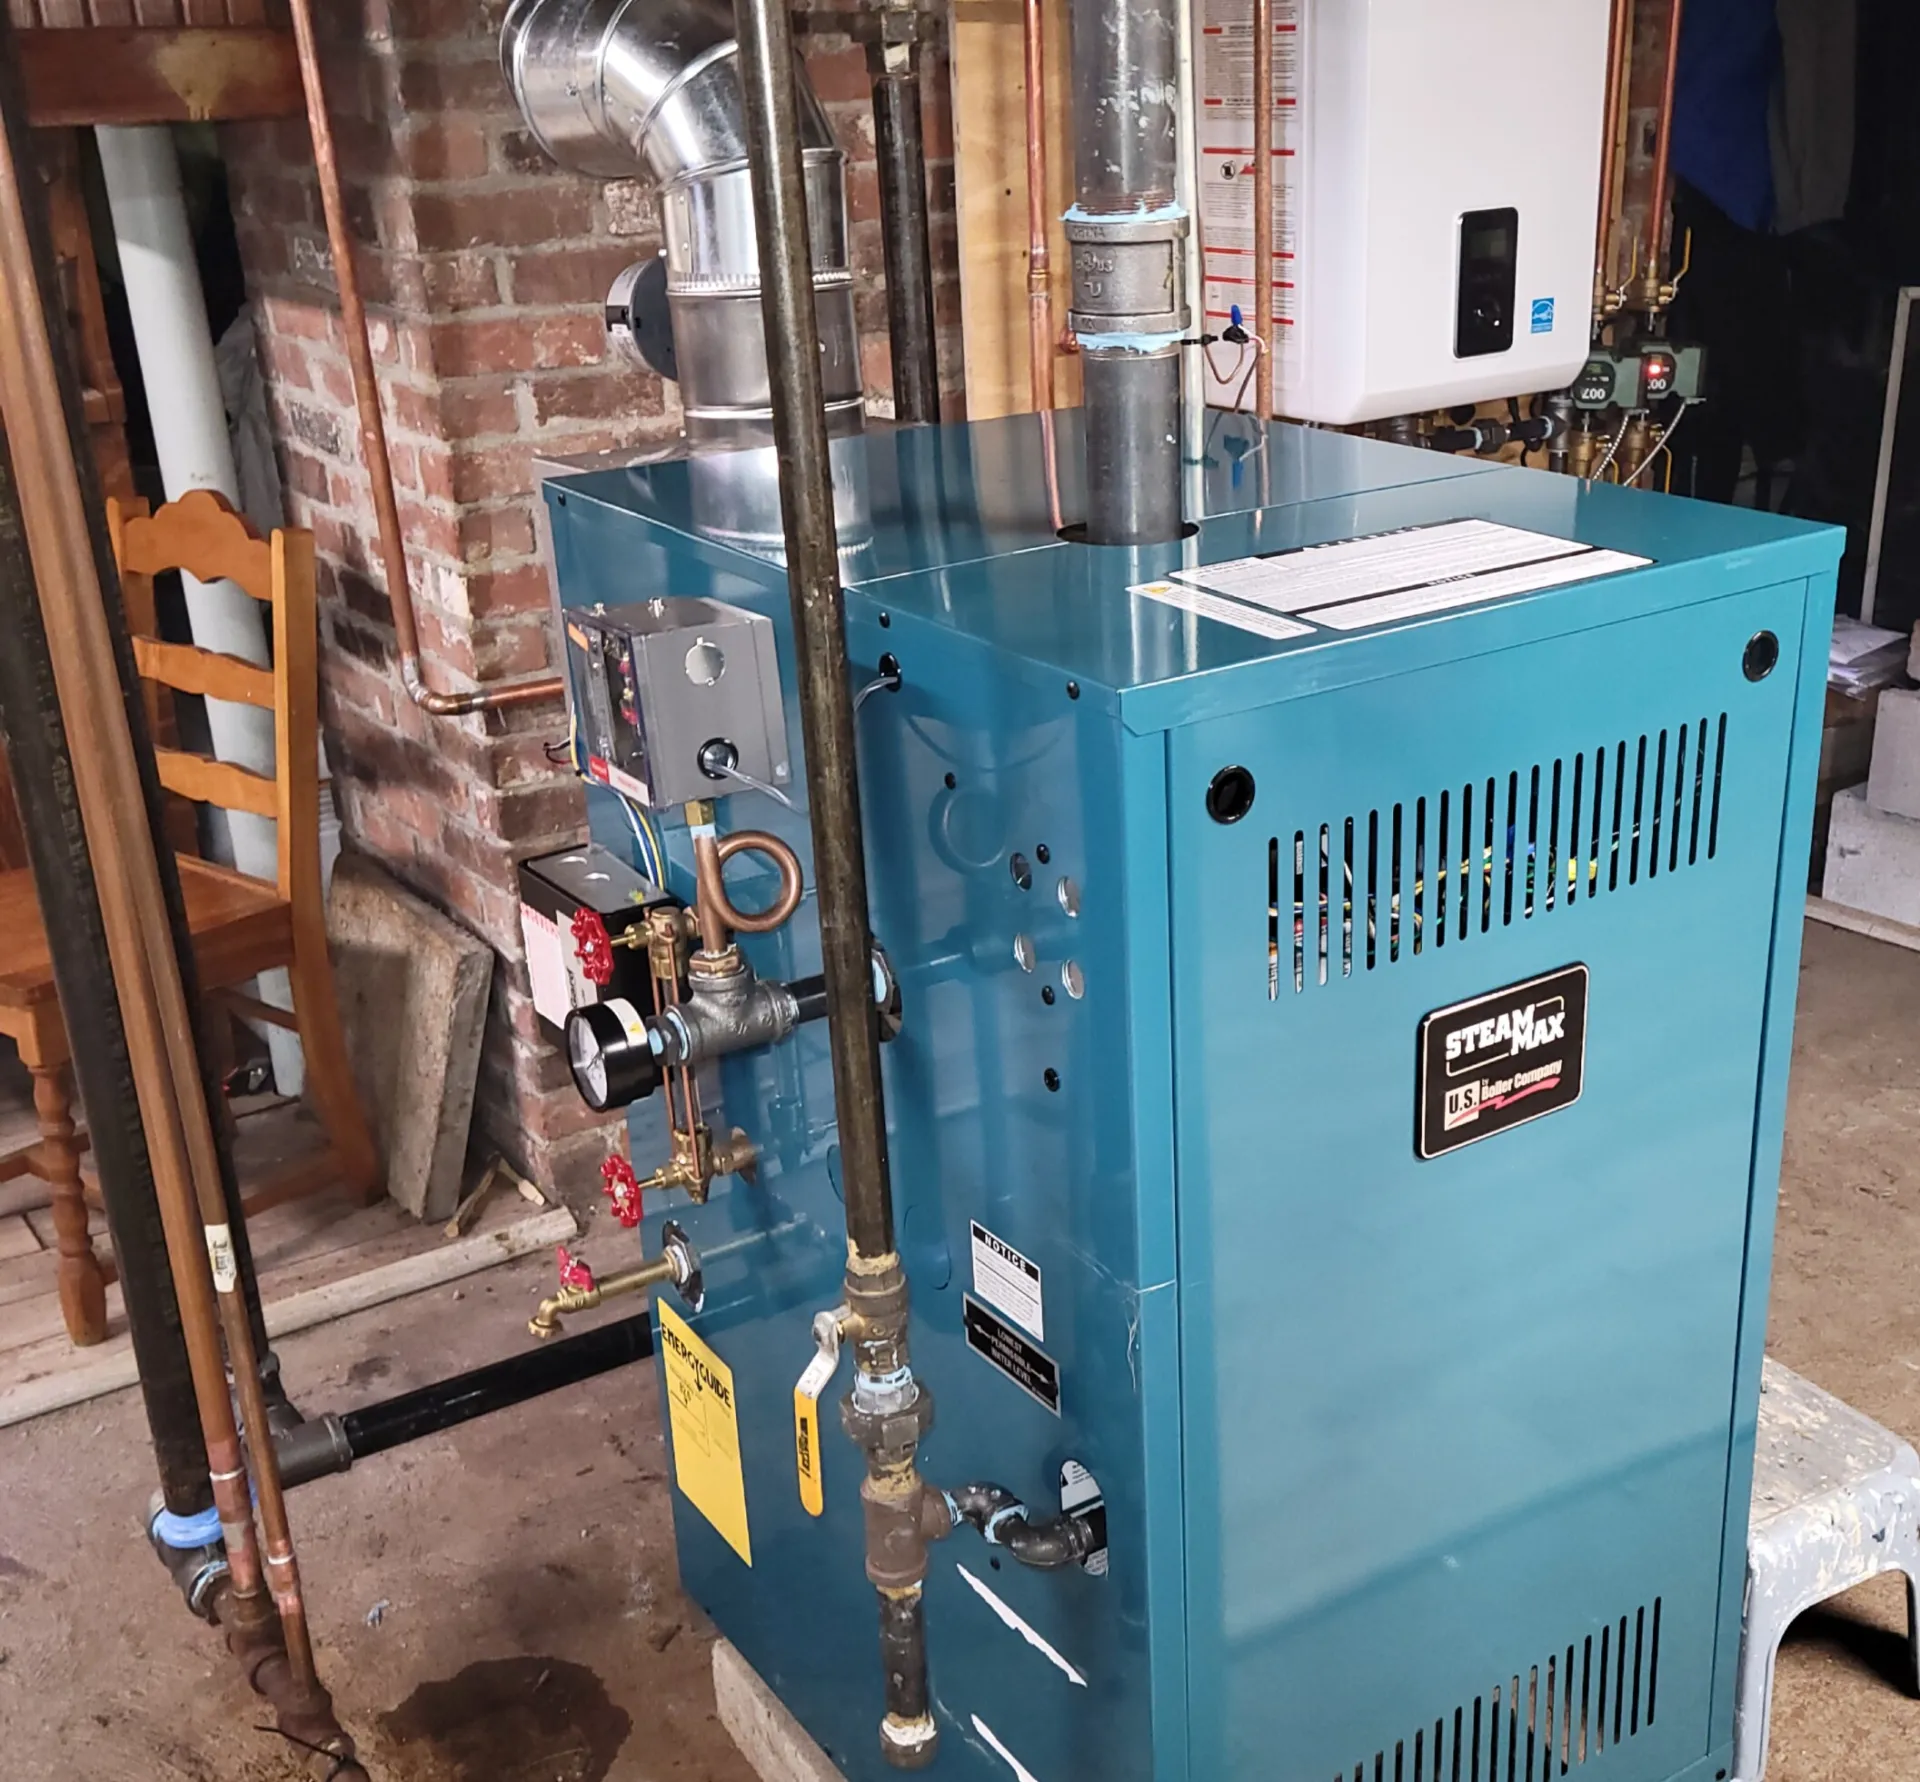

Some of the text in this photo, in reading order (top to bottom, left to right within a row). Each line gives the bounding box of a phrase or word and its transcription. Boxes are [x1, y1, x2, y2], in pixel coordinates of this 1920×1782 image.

[1581, 387, 1606, 400] 007
[1446, 1003, 1536, 1060] STEAM
[1511, 1012, 1565, 1056] MAX
[1449, 1088, 1477, 1115] U.S.
[984, 1233, 1028, 1273] NOTICE
